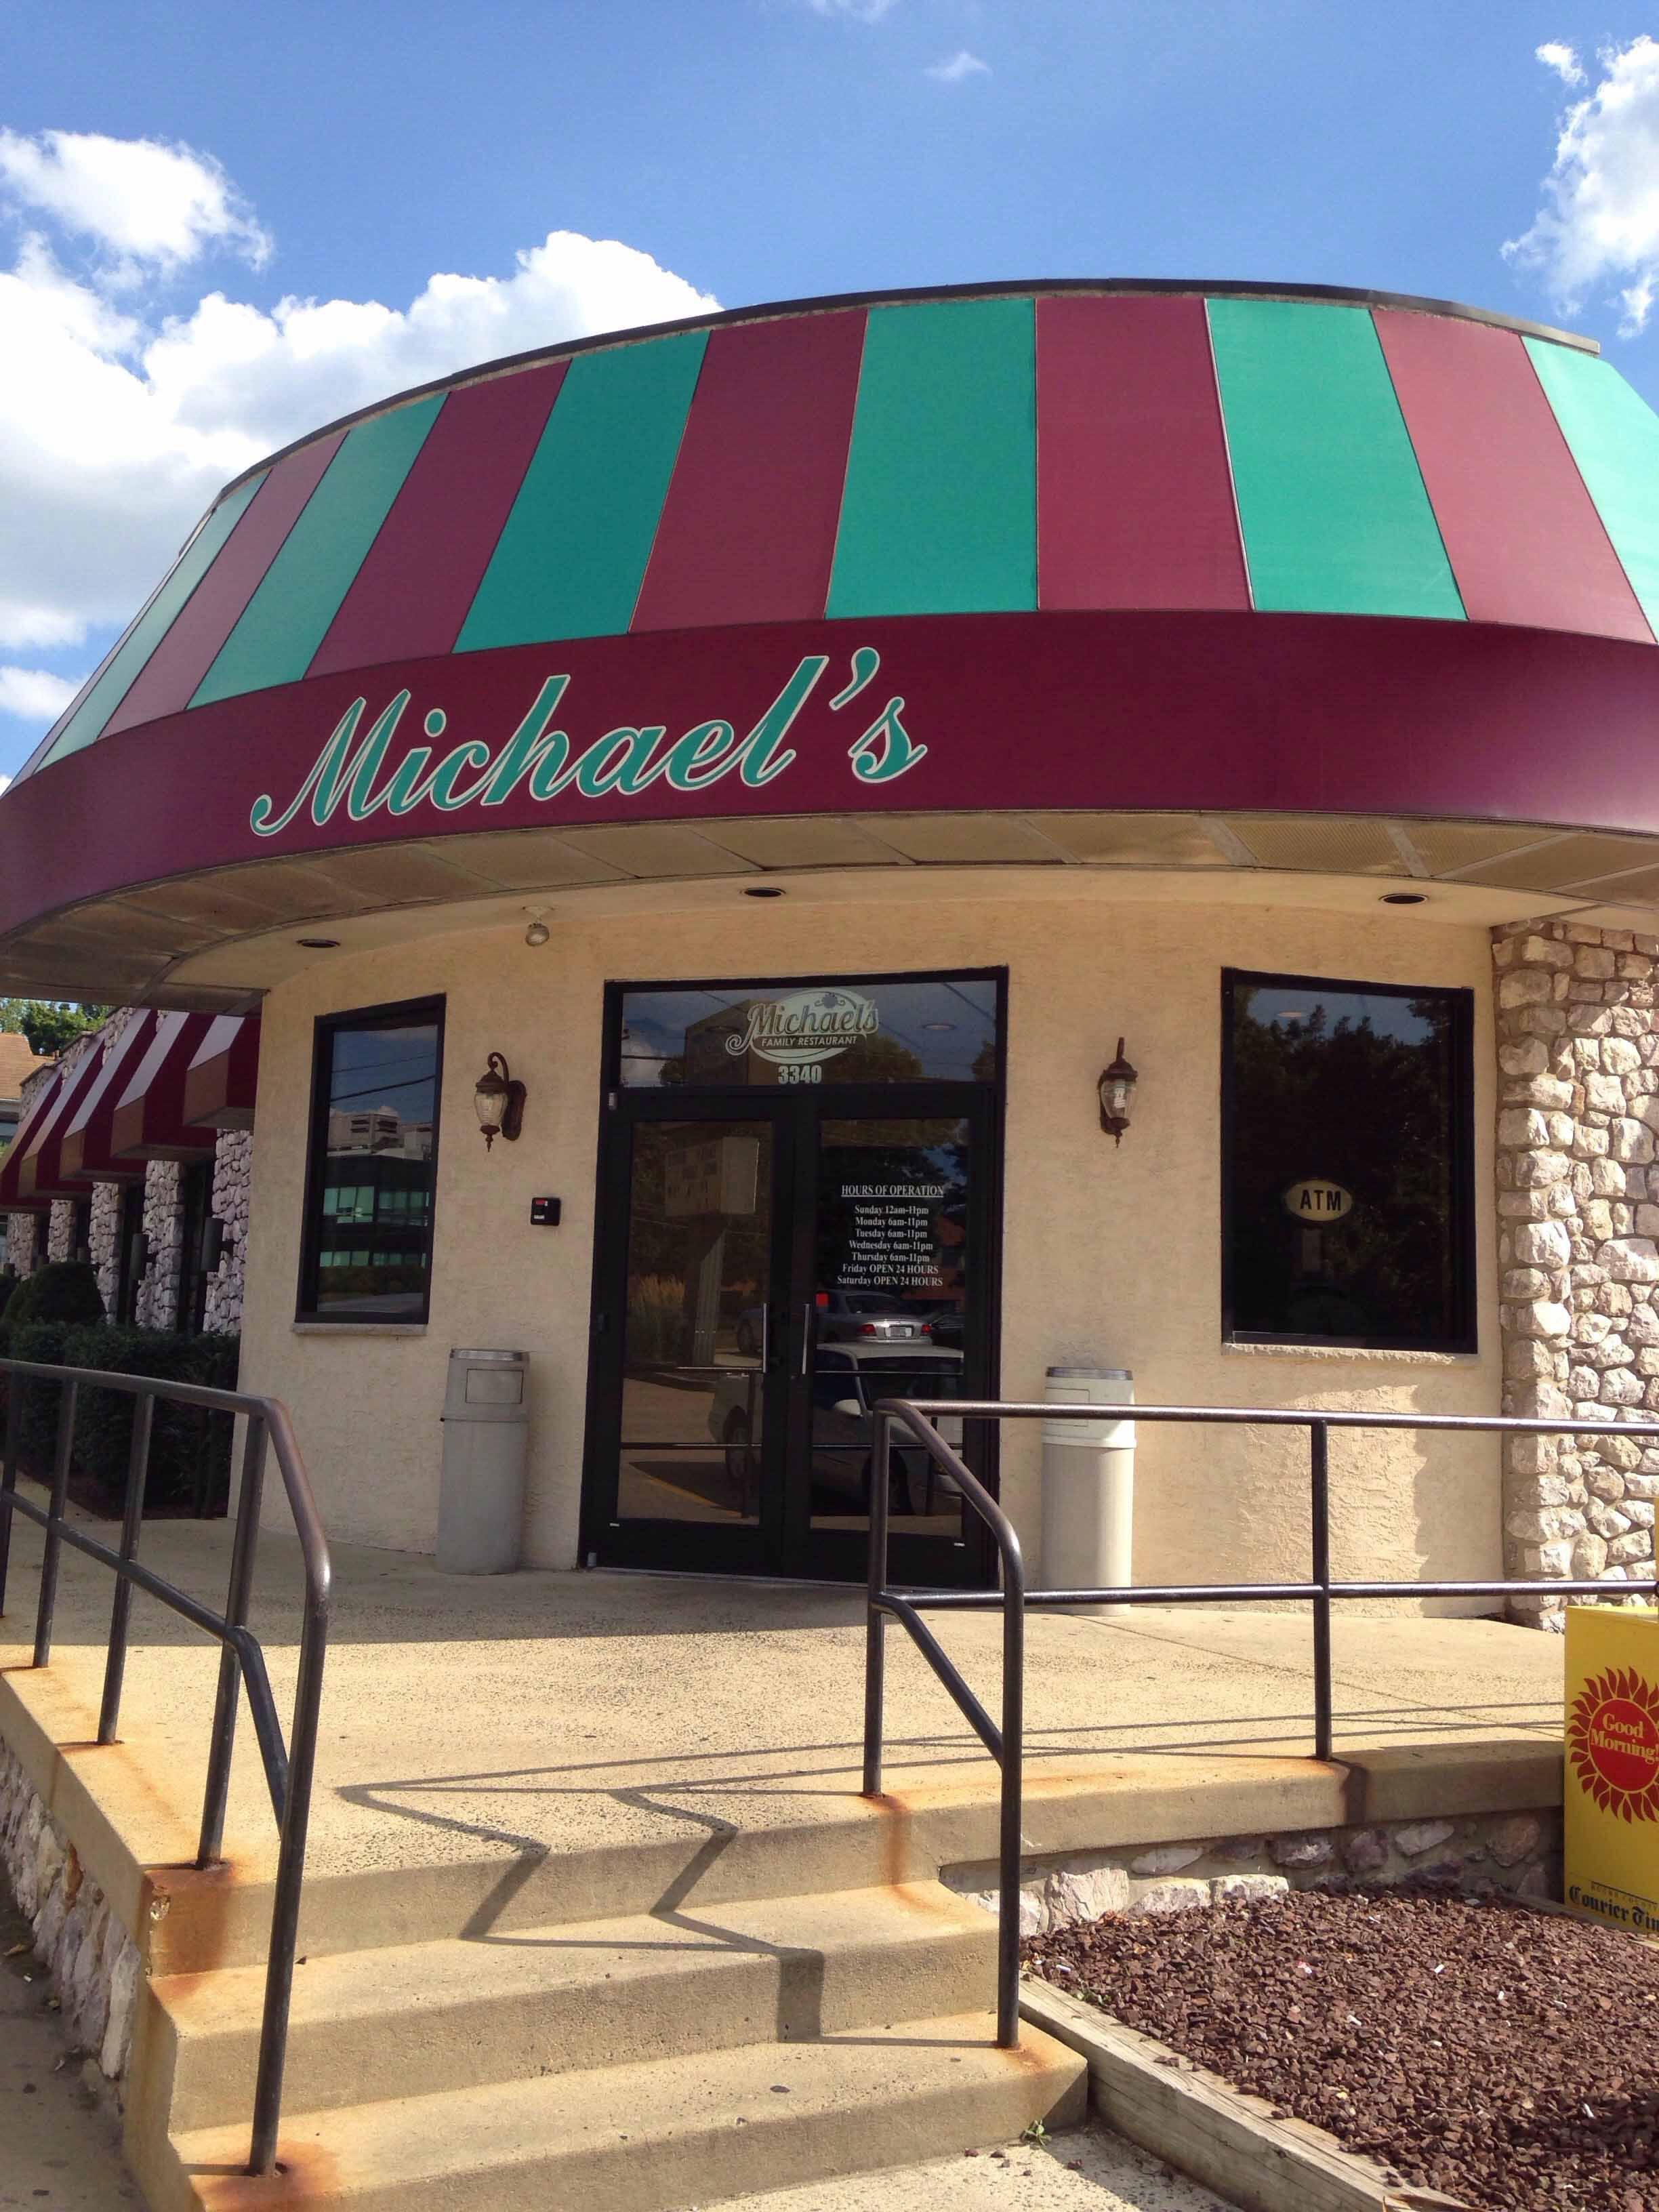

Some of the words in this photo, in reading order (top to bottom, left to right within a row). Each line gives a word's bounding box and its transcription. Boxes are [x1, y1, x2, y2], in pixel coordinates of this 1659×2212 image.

[251, 647, 927, 837] Michael's
[761, 1036, 796, 1047] FAMILY
[798, 1036, 857, 1046] RESTAURANT
[777, 1065, 823, 1085] 3340
[842, 1185, 874, 1195] HOURS
[876, 1185, 888, 1195] OF
[890, 1185, 944, 1196] OPERATION
[1300, 1189, 1342, 1211] ATM
[855, 1205, 883, 1216] Sunday
[885, 1206, 929, 1216] 12am-11pm
[855, 1216, 886, 1227] Monday
[888, 1217, 928, 1228] 6am-11pm
[855, 1229, 885, 1240] Tuesday
[888, 1229, 928, 1240] 6am-11pm
[849, 1240, 891, 1251] Wednesday
[893, 1242, 933, 1252] 6am-11pm
[852, 1252, 888, 1263] Thursday
[890, 1253, 930, 1264] 6am-11pm
[842, 1264, 867, 1275] Friday
[869, 1264, 894, 1273] OPEN
[895, 1265, 905, 1273] 24
[907, 1265, 939, 1274] HOURS
[837, 1275, 872, 1286] Saturday
[874, 1276, 898, 1286] OPEN
[900, 1277, 909, 1286] 24
[912, 1277, 943, 1286] HOURS
[1602, 1713, 1643, 1738] Good
[1569, 1886, 1629, 1921] Courier
